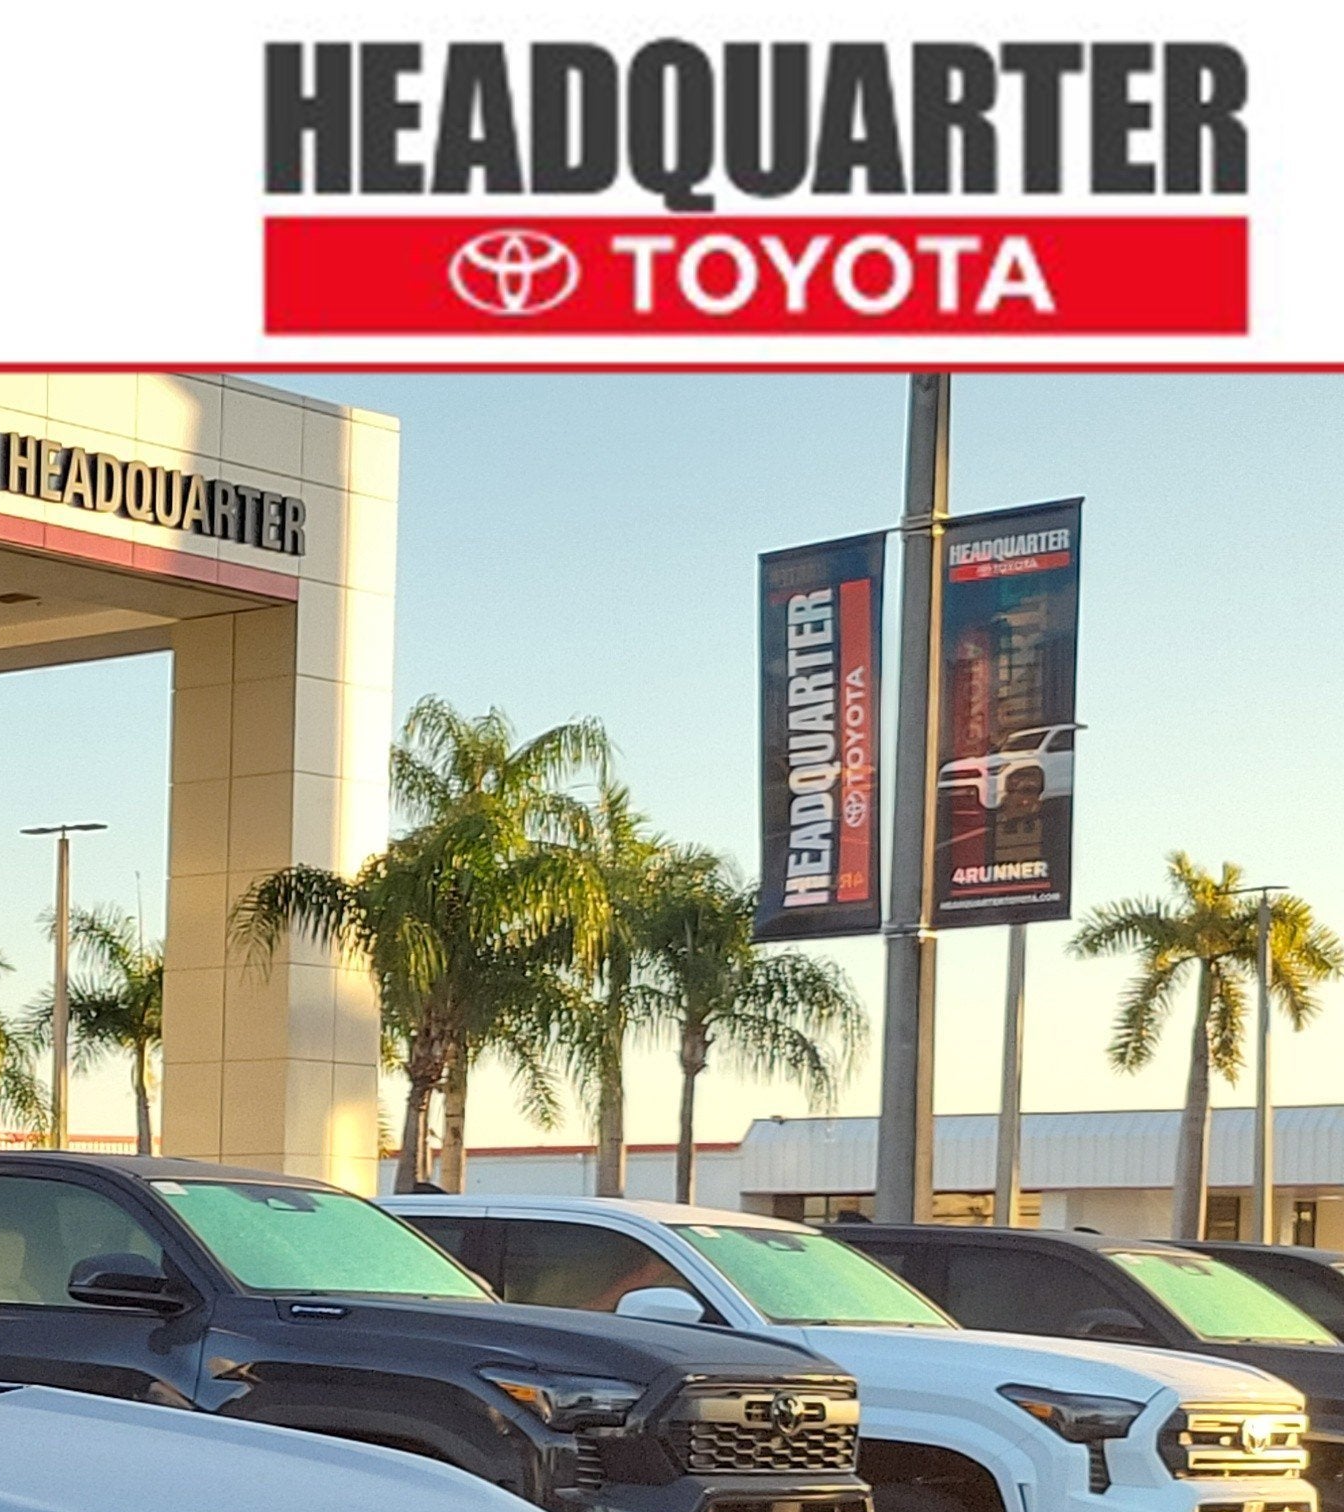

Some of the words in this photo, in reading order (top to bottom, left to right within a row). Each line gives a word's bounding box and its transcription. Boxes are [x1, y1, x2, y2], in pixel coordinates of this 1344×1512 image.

[949, 528, 1070, 565] HEADQUARTER
[784, 588, 841, 908] HEADQUARTER
[846, 666, 866, 786] TOYOTA
[952, 861, 1049, 884] 4RUNNER
